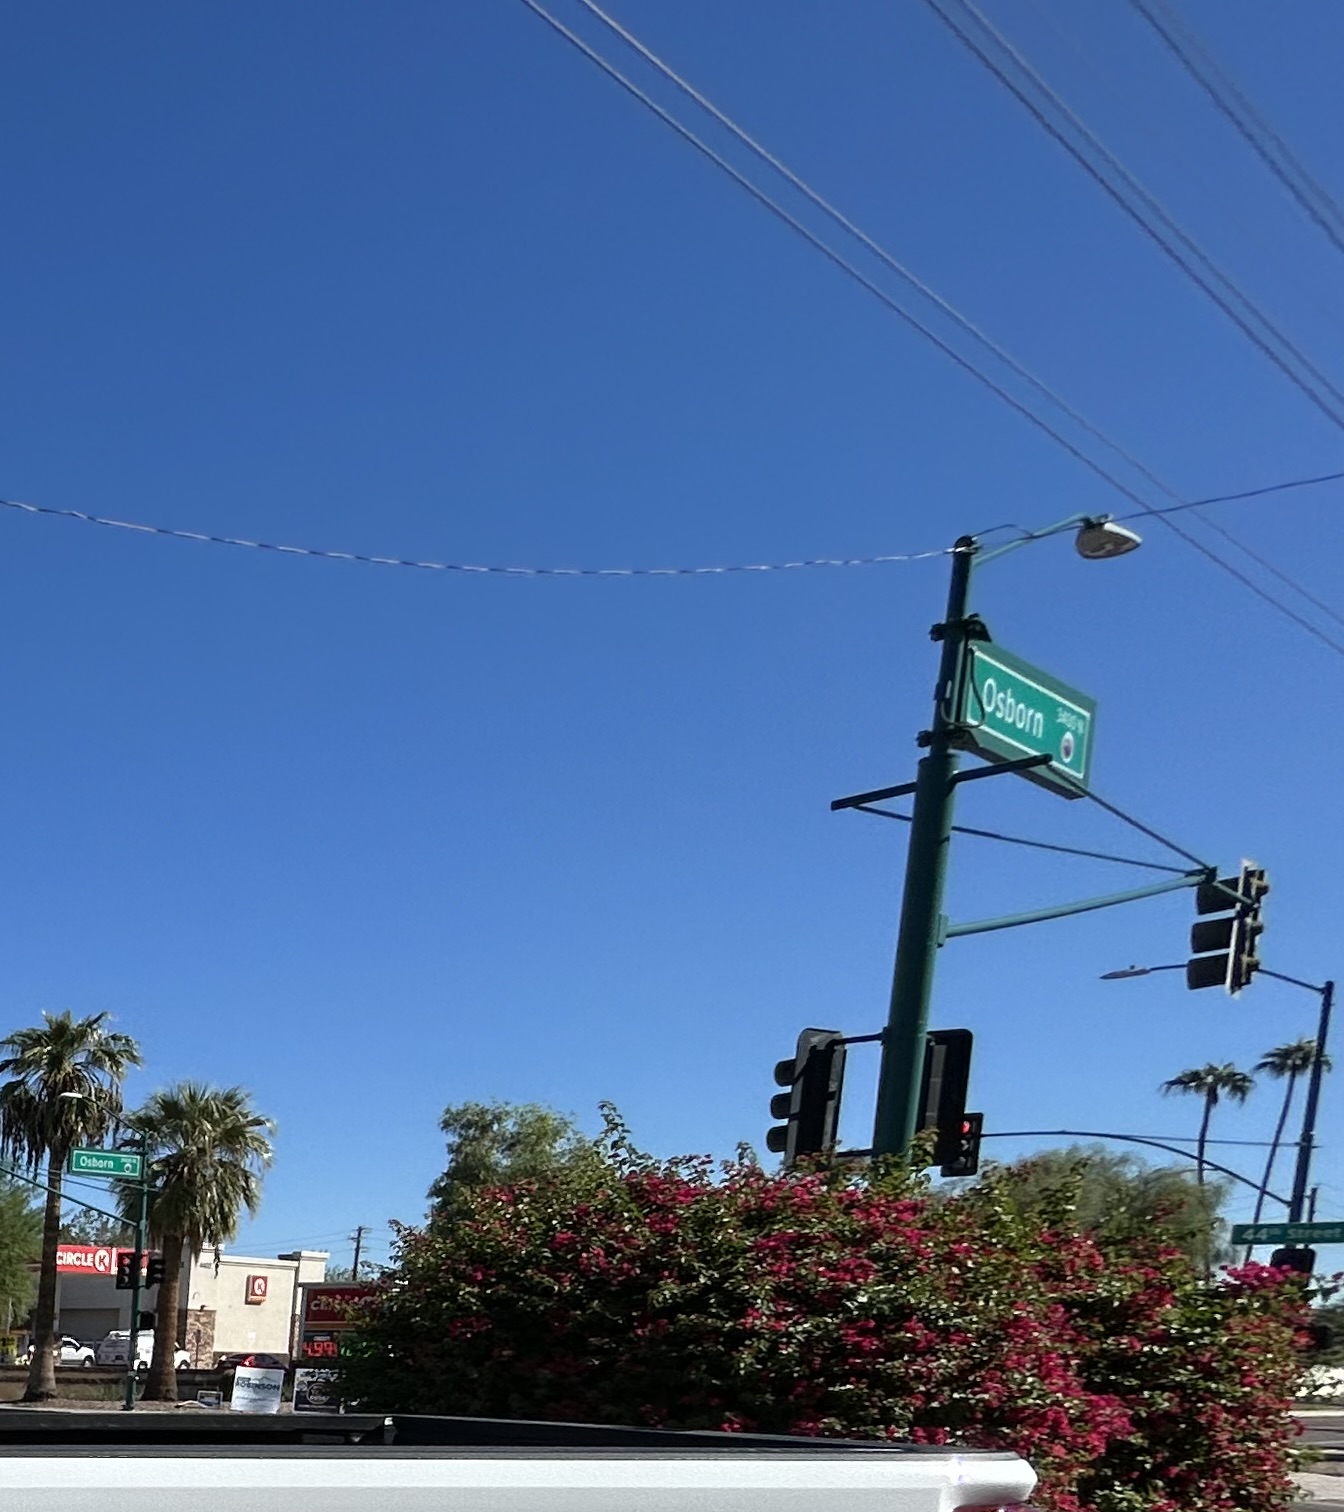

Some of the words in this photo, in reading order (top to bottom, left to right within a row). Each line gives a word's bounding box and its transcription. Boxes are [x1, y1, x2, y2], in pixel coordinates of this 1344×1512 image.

[983, 678, 1044, 738] Osborn
[79, 1156, 114, 1169] Osborn
[56, 1251, 94, 1267] CIRCLE
[97, 1251, 110, 1272] K
